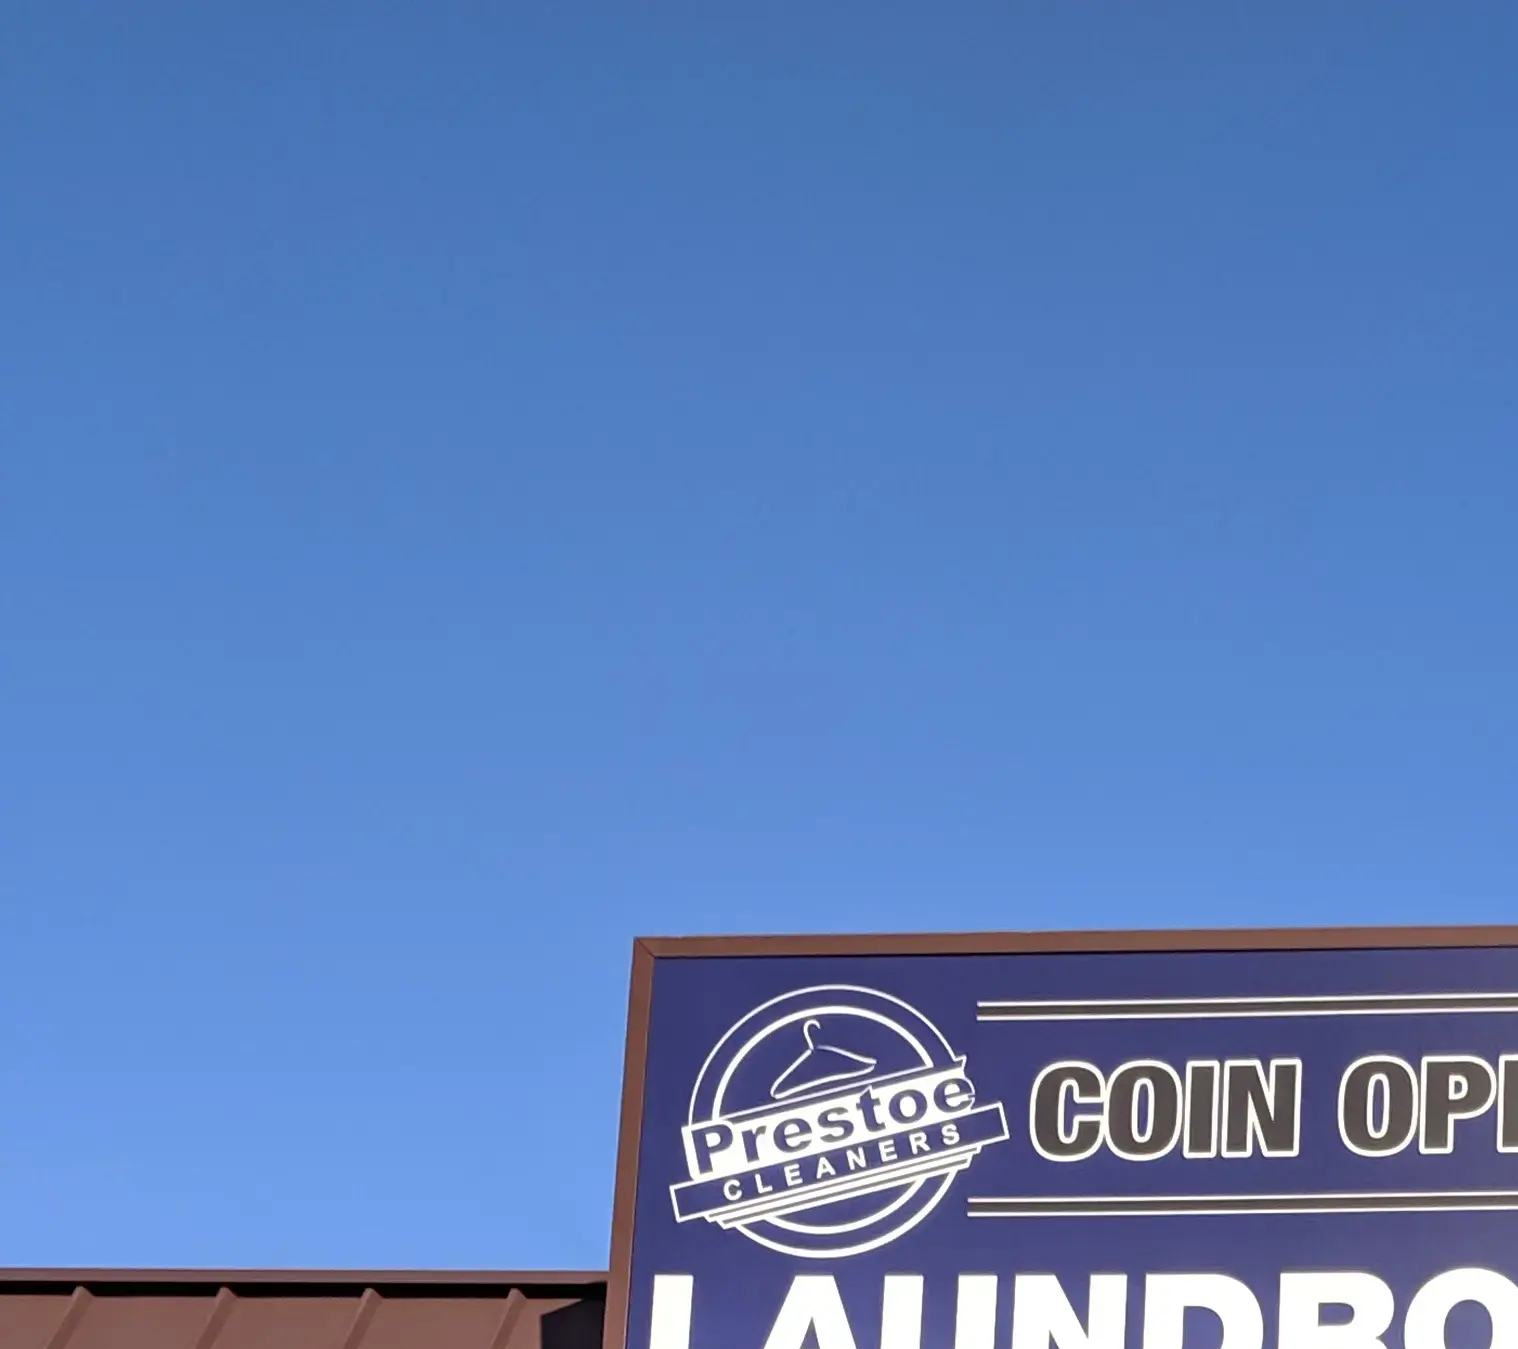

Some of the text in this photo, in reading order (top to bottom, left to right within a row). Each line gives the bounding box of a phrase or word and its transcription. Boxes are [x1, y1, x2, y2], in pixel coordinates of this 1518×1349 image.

[691, 1076, 976, 1175] Prestoe
[1029, 1058, 1303, 1163] COIN
[722, 1123, 961, 1201] CLEANERS
